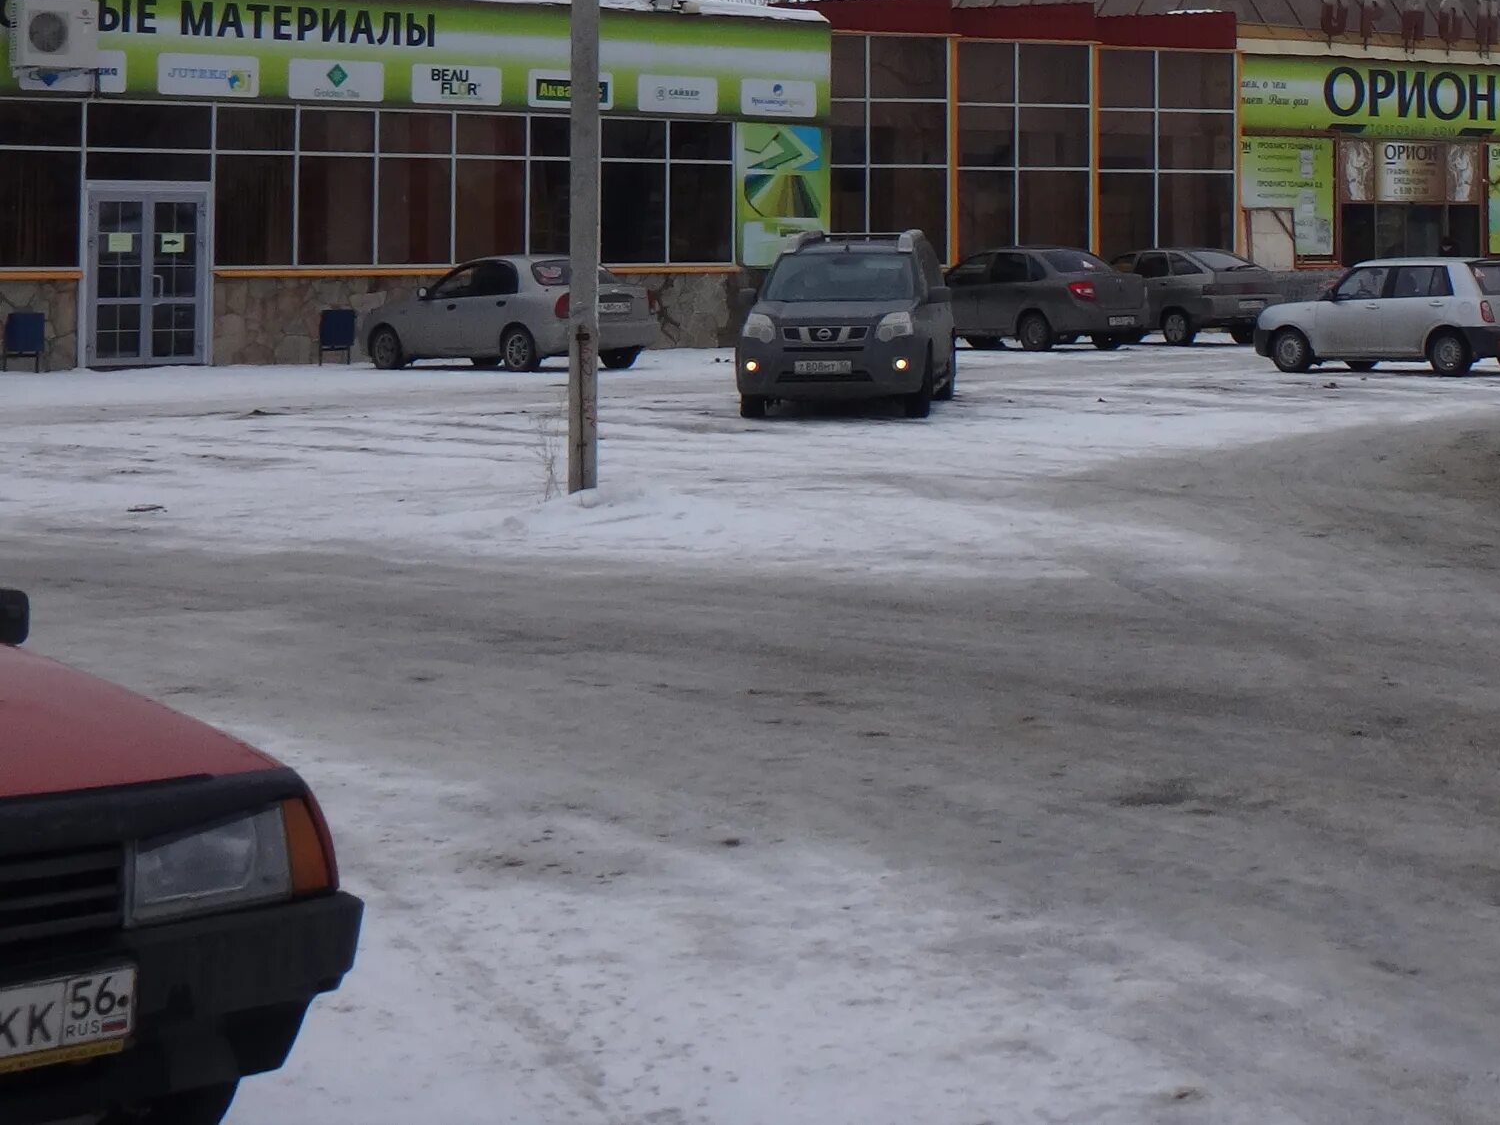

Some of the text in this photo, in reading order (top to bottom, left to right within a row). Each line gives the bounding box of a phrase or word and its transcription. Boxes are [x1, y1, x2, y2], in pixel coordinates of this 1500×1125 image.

[180, 0, 436, 47] МАТЕРИАЛЫ
[431, 68, 469, 83] BEAU
[1323, 66, 1497, 121] ОРИОН
[1384, 144, 1438, 161] ОРИОН
[71, 977, 116, 1021] 56
[65, 1018, 100, 1037] RUS
